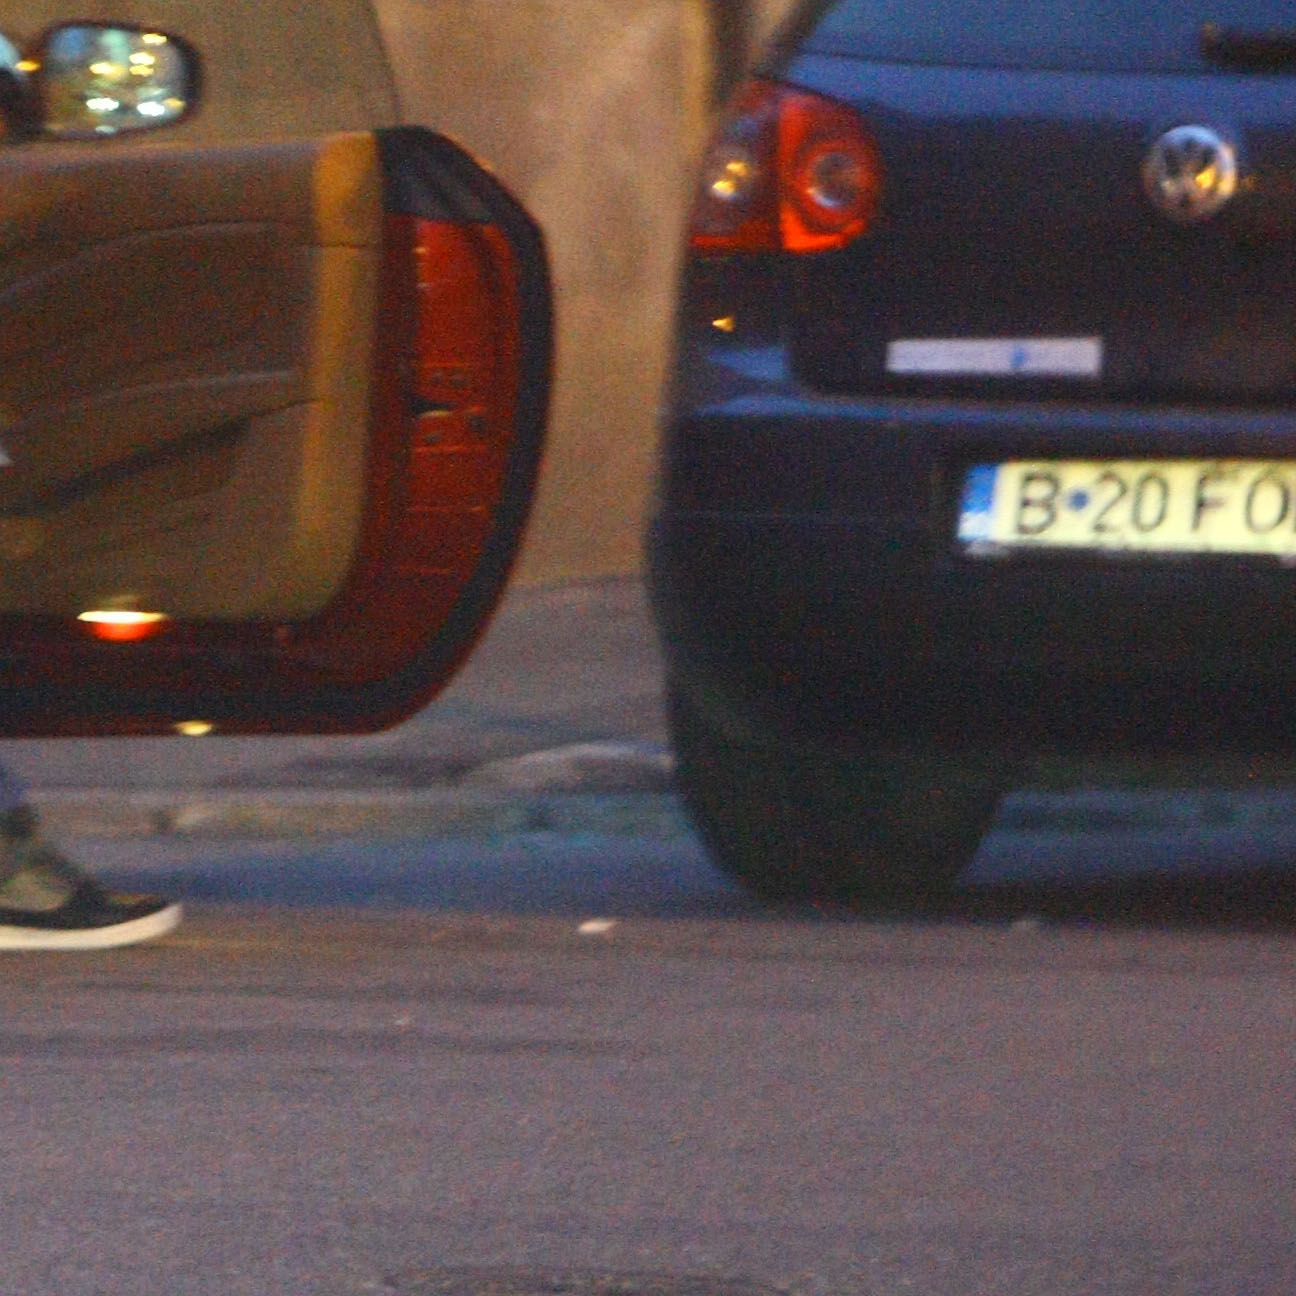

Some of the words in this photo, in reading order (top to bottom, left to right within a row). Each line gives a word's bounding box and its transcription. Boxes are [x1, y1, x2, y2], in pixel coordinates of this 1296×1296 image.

[1014, 470, 1059, 535] B
[1093, 471, 1169, 534] 20
[1191, 468, 1296, 535] FO
